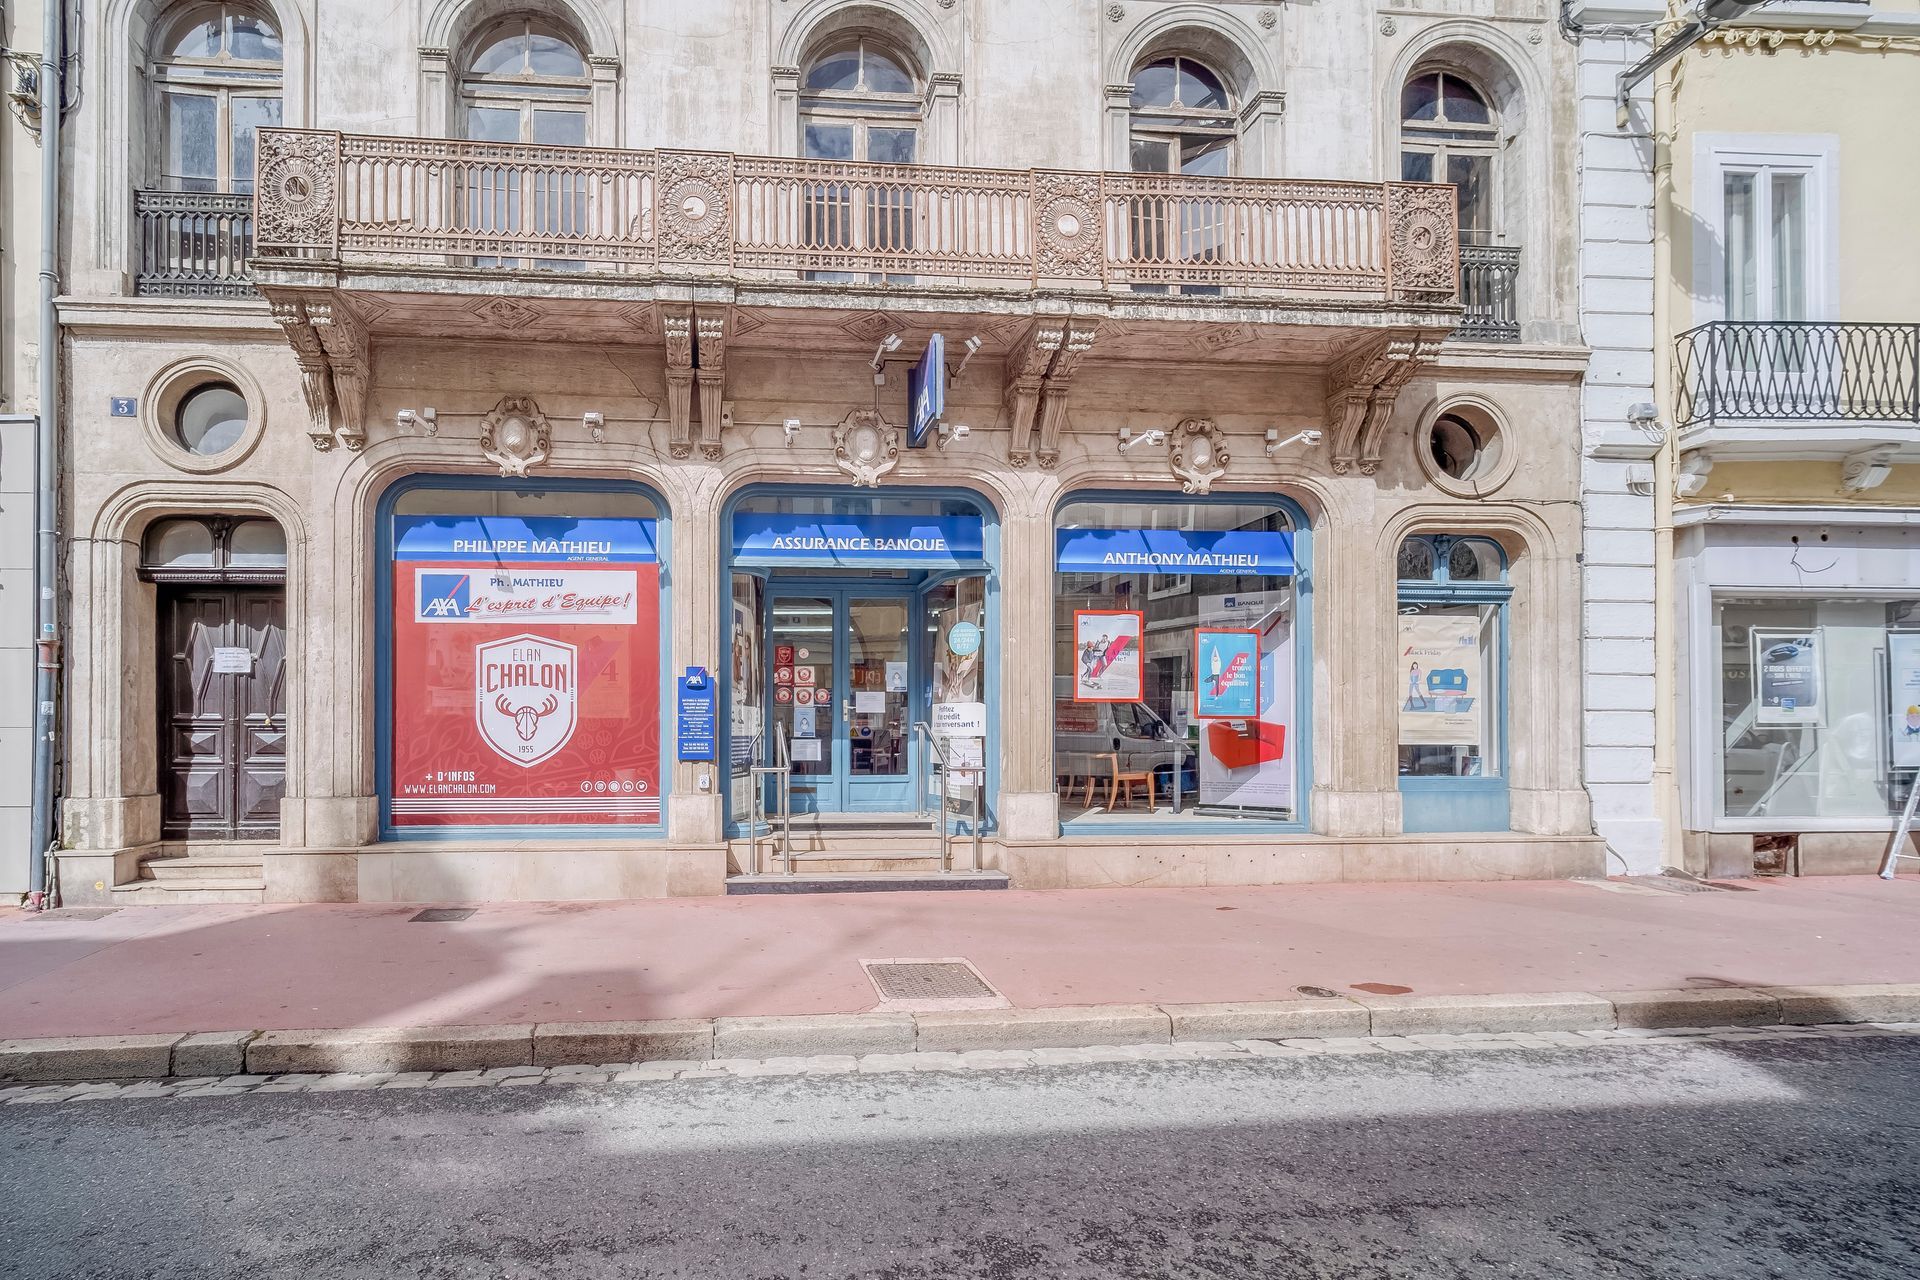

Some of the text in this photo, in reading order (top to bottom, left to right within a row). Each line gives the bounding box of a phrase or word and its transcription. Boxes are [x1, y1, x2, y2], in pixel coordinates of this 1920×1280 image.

[119, 400, 128, 414] 3
[454, 540, 611, 554] PHILIPPE MATHIEU
[772, 538, 945, 551] ASSURANCE BANQUE
[1103, 552, 1259, 567] ANTHONY MATHIEU
[513, 578, 564, 588] MATHIEU
[422, 598, 460, 616] AXA
[464, 596, 536, 612] L'esprit
[512, 648, 541, 662] ELAN
[486, 664, 567, 693] CHALON
[686, 676, 702, 684] AXA
[437, 771, 475, 782] D'INFOS
[404, 784, 496, 794] WWW.ELANCHALON.COM
